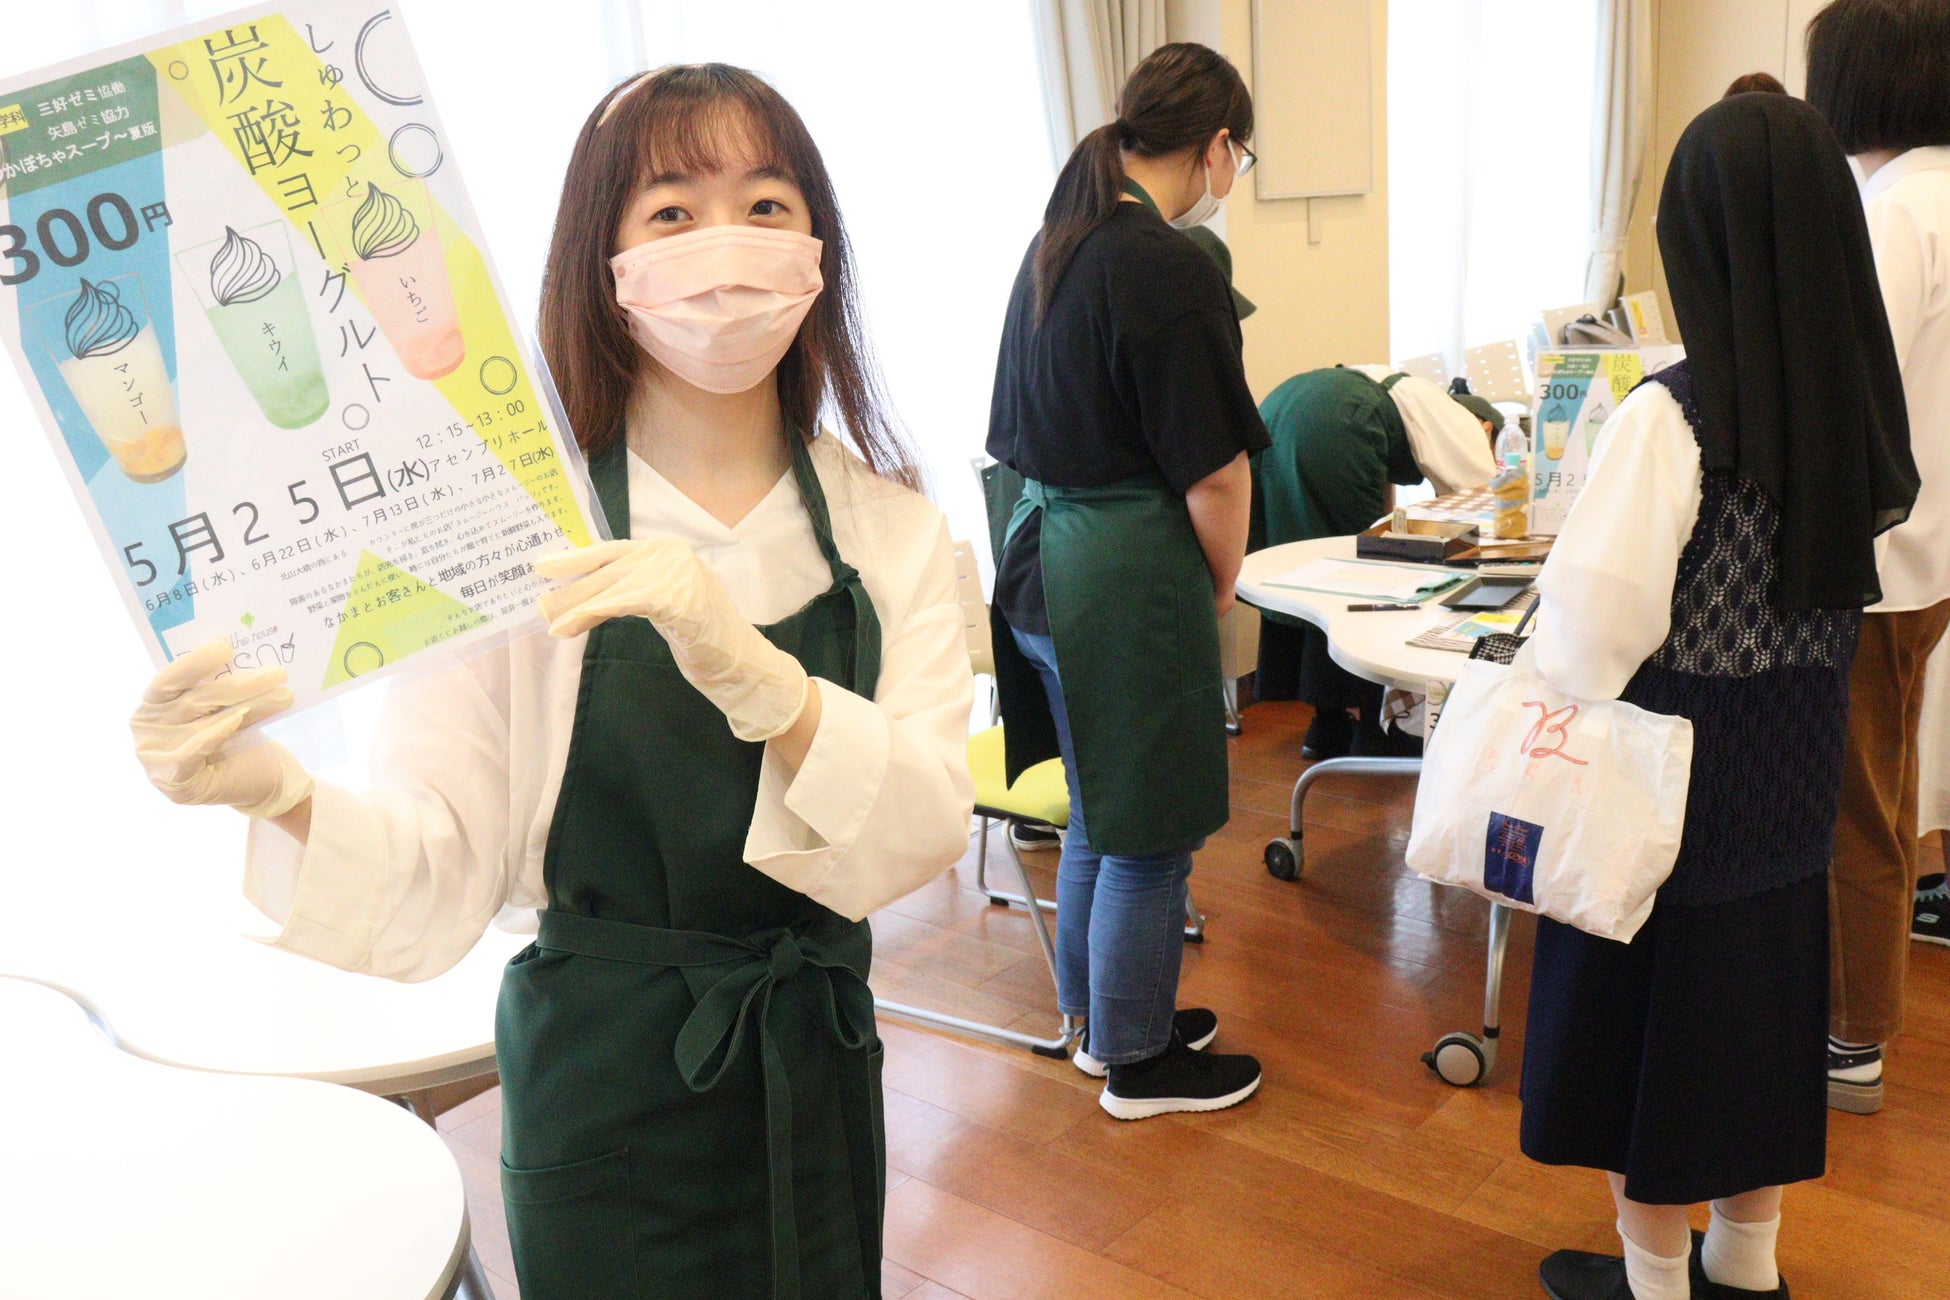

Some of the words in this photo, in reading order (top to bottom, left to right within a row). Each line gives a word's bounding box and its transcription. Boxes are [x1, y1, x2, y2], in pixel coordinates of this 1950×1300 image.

[203, 25, 391, 403] 炭酸ヨーグルト
[399, 275, 429, 324] いちご
[261, 322, 289, 372] キウイ
[114, 362, 148, 425] マンゴー
[321, 438, 361, 462] START
